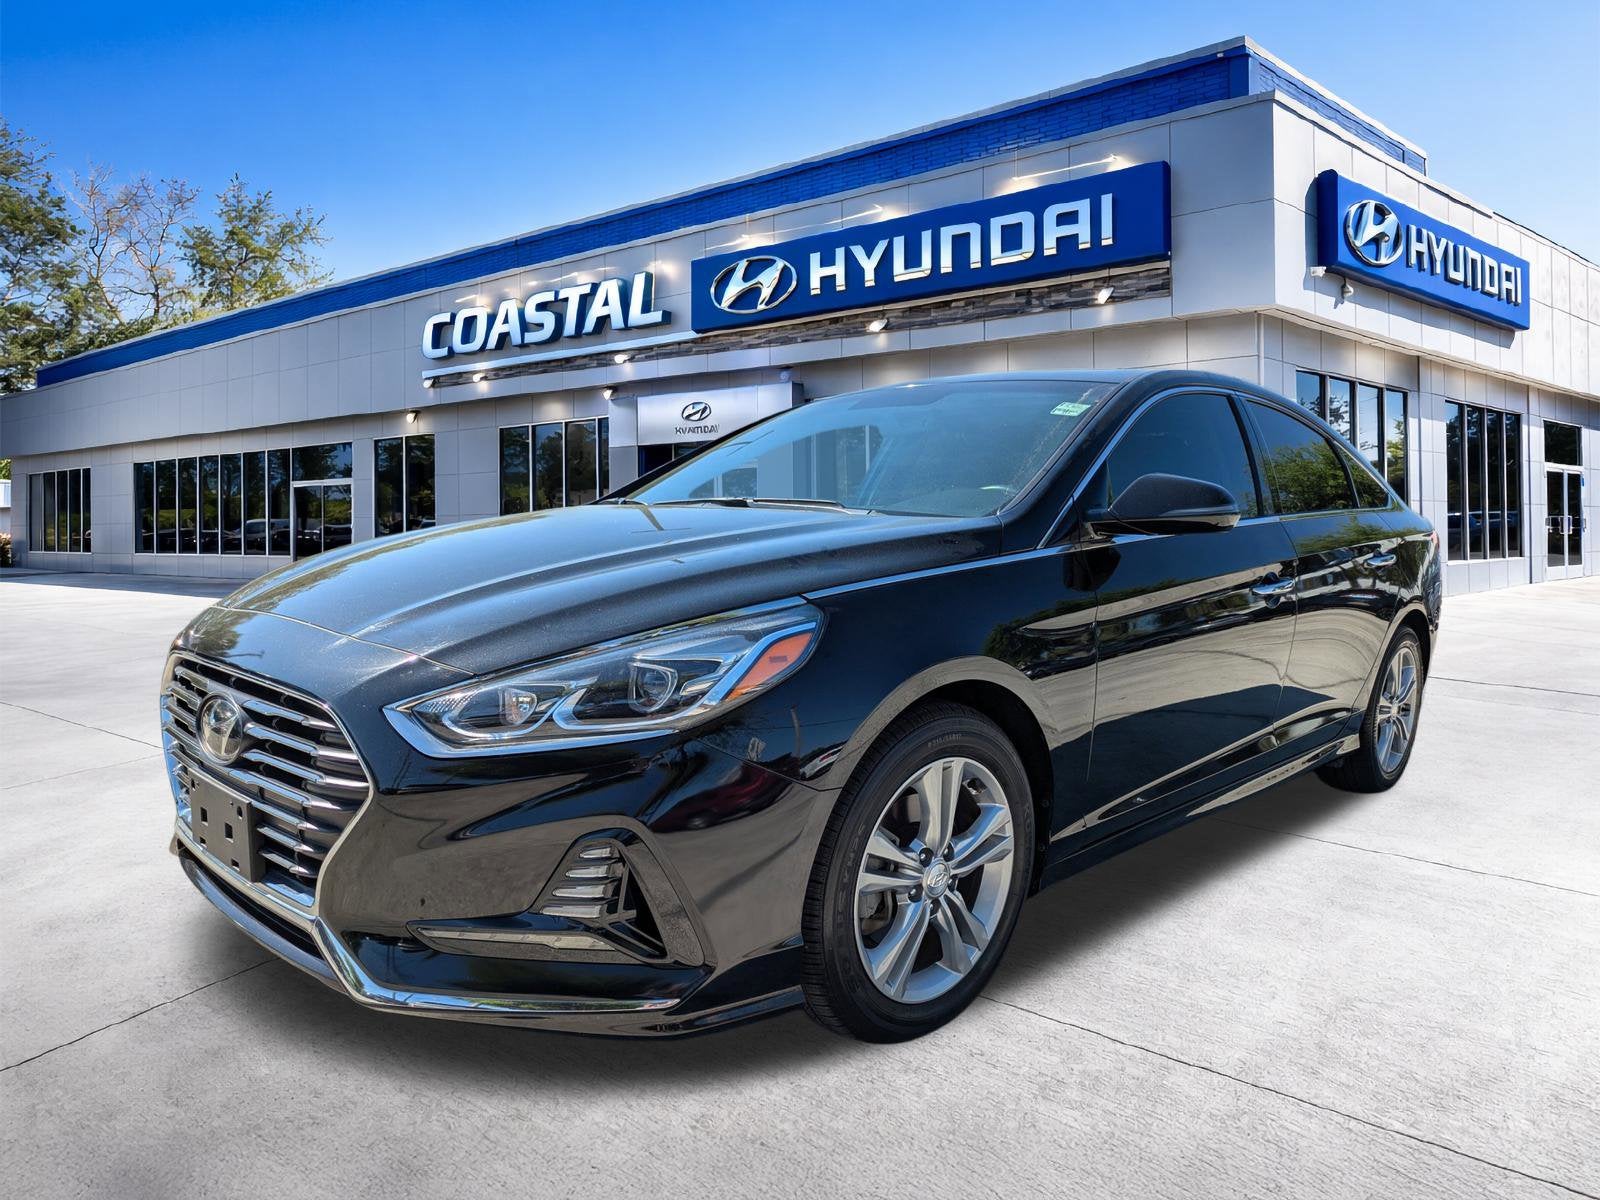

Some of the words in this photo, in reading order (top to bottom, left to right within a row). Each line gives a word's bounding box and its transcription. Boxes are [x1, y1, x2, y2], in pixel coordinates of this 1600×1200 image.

[809, 192, 1114, 296] HYUNDAI
[1406, 223, 1522, 306] HYUNDAI
[421, 271, 669, 360] COASTAL
